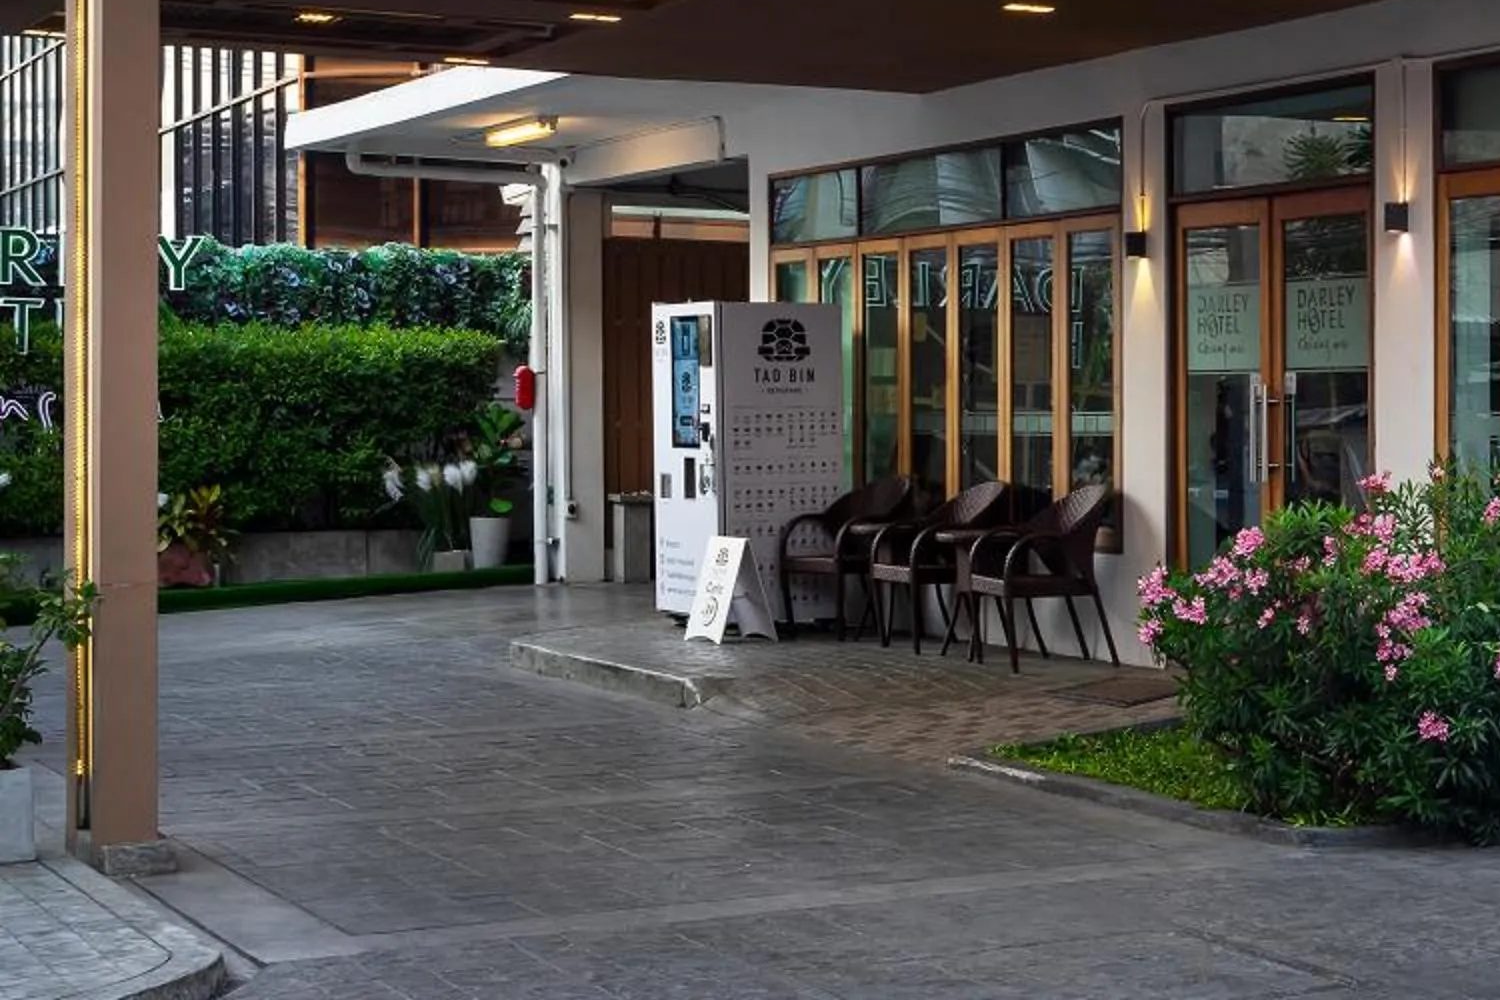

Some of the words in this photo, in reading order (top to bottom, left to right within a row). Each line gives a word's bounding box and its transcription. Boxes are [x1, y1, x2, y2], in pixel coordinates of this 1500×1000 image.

[1197, 293, 1248, 313] DARLEY
[1297, 284, 1355, 309] DARLEY
[1197, 313, 1240, 338] HOTEL
[1297, 307, 1345, 335] HOTEL
[754, 368, 781, 383] TAO
[788, 368, 815, 383] BIN
